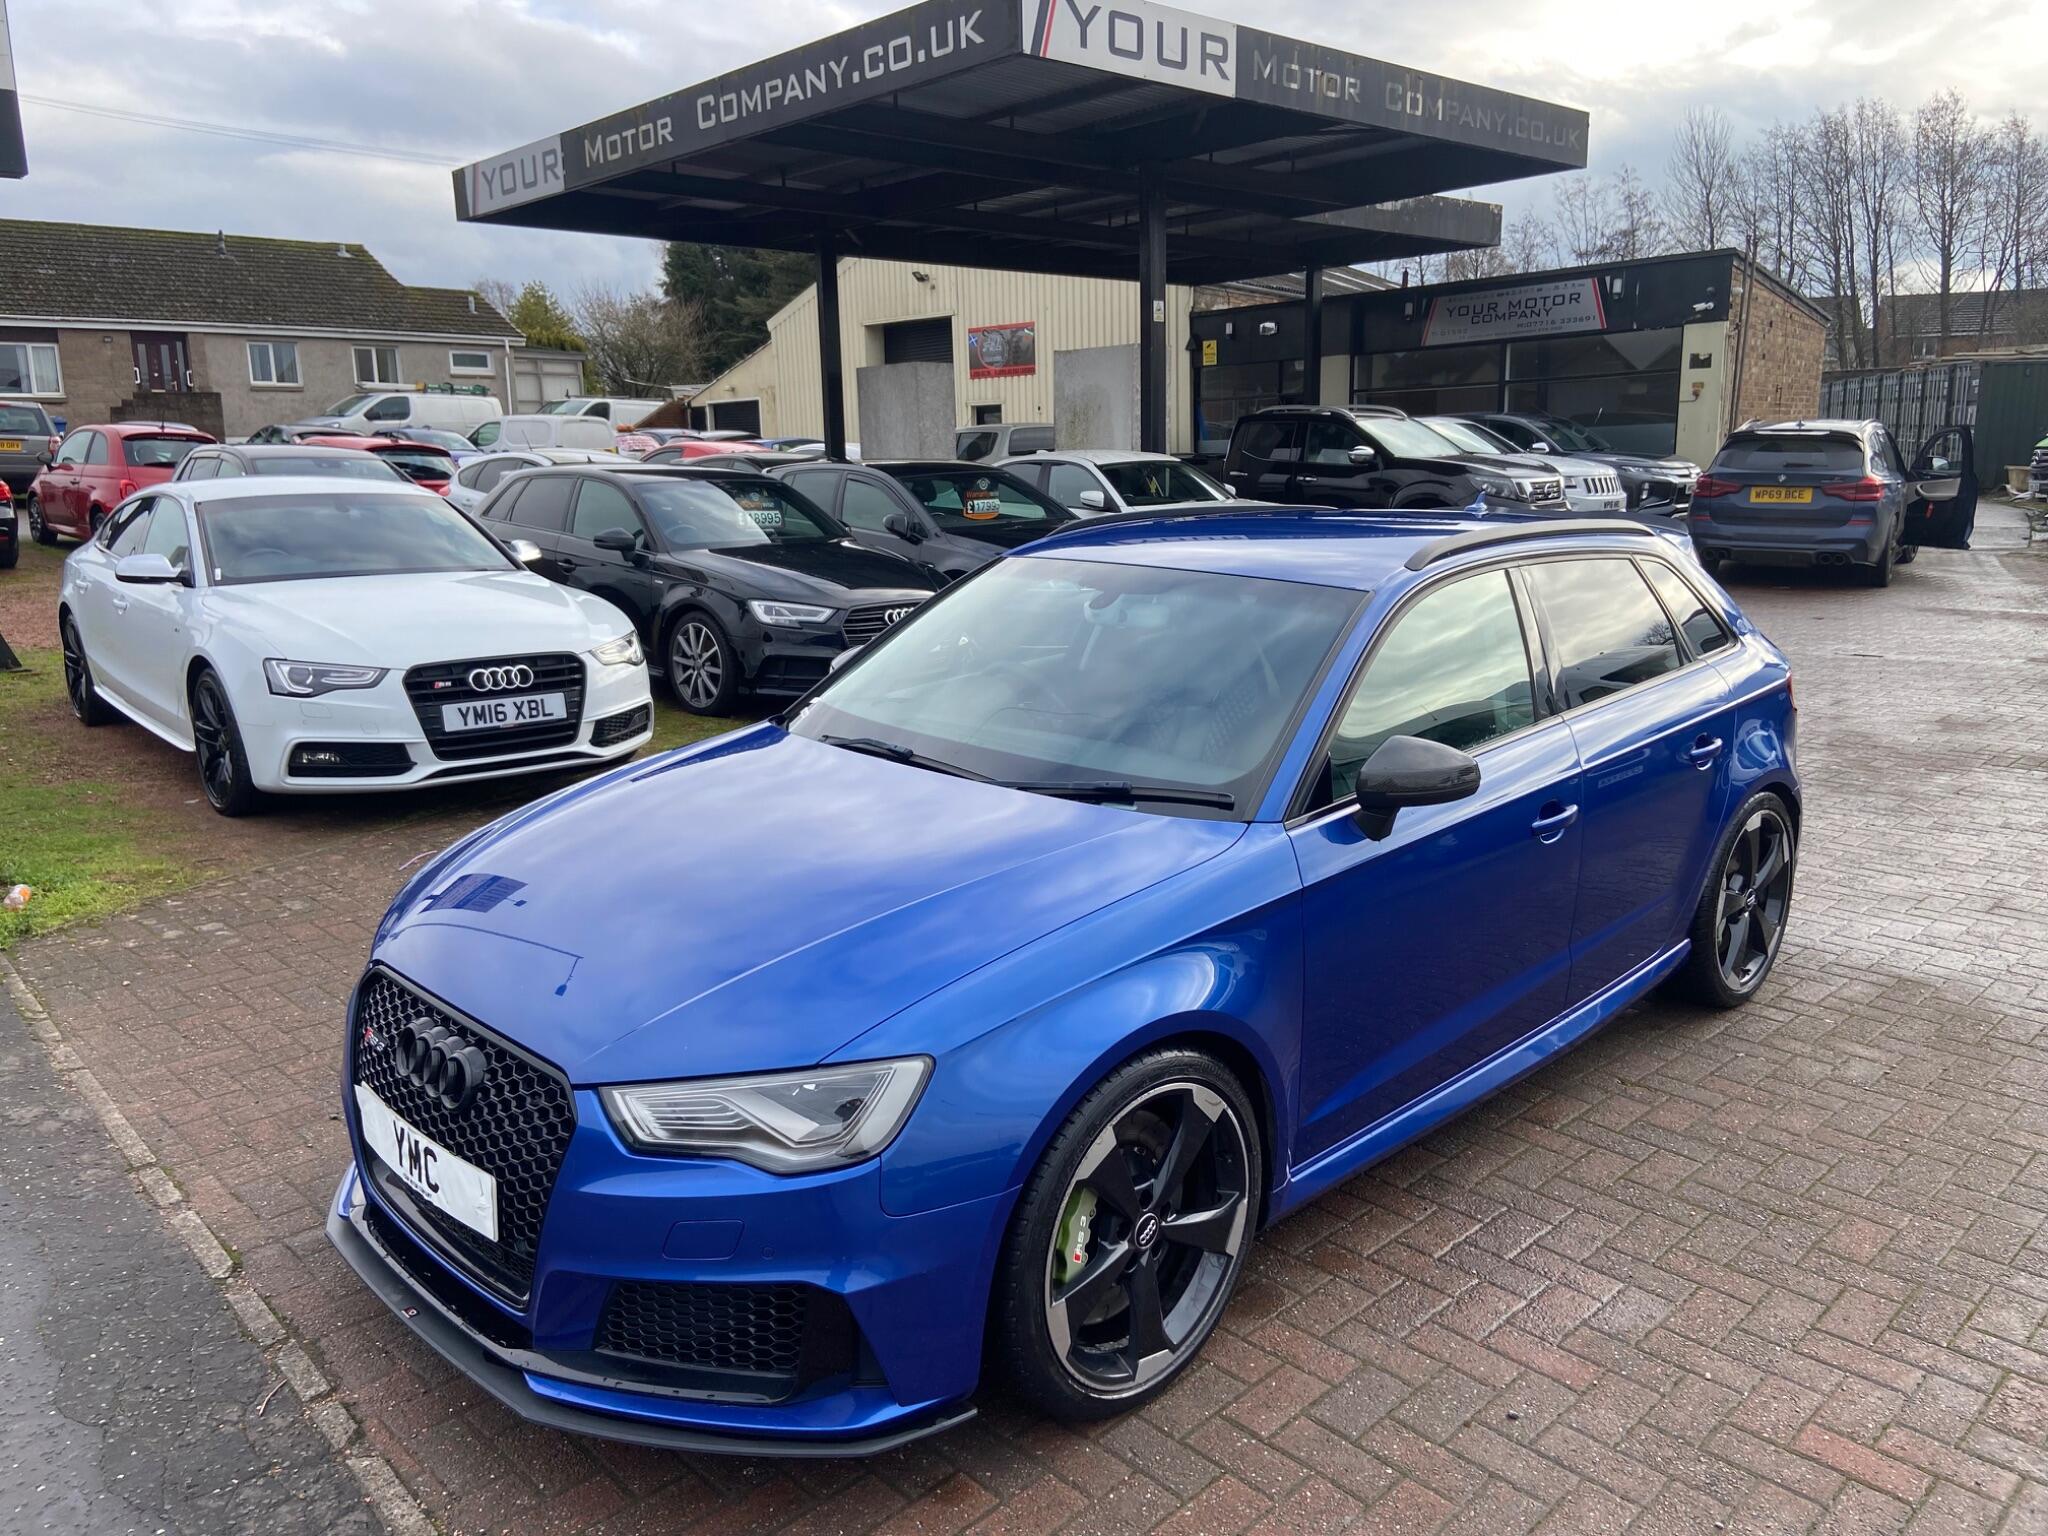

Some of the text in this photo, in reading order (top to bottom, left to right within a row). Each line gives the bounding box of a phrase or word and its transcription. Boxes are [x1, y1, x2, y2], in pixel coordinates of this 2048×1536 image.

[1065, 0, 1581, 149] YOUR MOTOR COMPANY.CO.UK
[481, 9, 985, 199] YOUR MOTOR COMPANY.CO.UK
[1446, 292, 1581, 318] YOUR MOTOR
[1471, 307, 1553, 325] COMPANY
[1755, 489, 1781, 500] WP69
[457, 698, 554, 727] YM16 XBL
[393, 1119, 440, 1194] YMC
